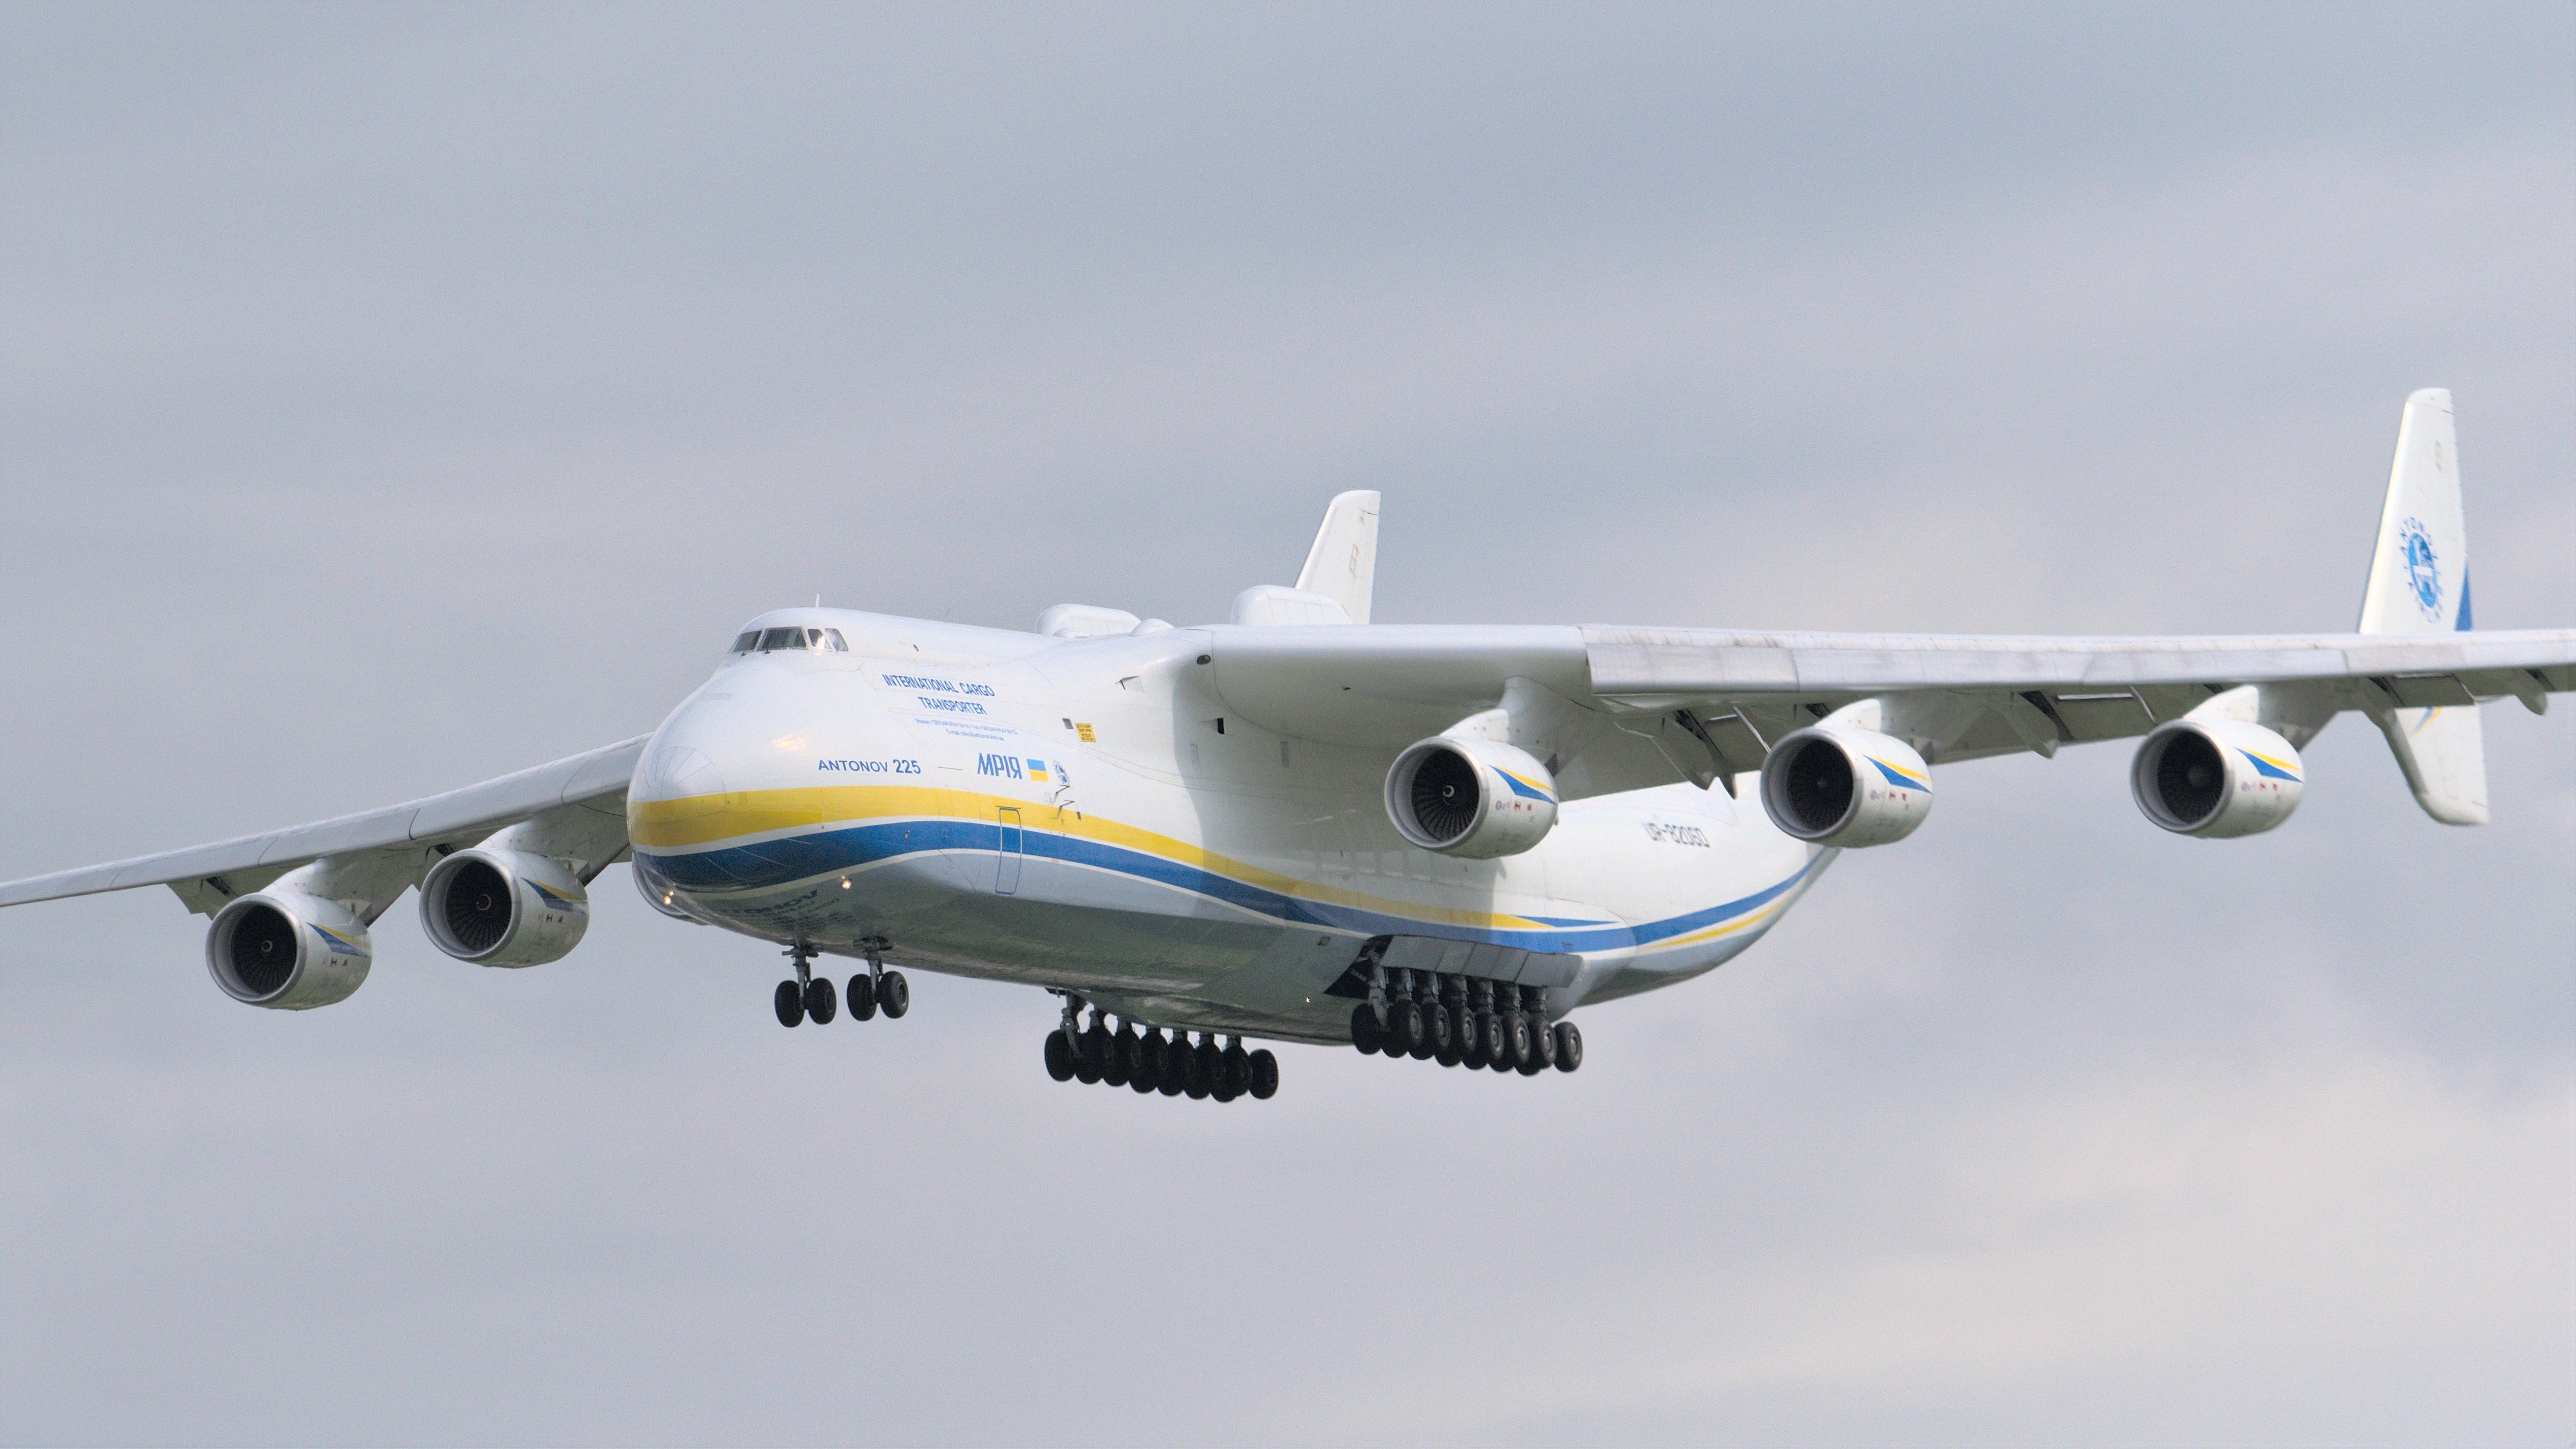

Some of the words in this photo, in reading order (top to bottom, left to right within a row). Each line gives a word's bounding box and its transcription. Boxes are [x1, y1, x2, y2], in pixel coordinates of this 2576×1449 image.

[882, 674, 959, 693] INTERNATIONAL
[959, 682, 995, 697] CARGO
[917, 697, 987, 715] TRANSPORTER
[818, 759, 887, 772] ANTONOV
[892, 759, 921, 774] 225
[977, 753, 1022, 779] МРІЯ
[1641, 820, 1710, 848] UR-82060
